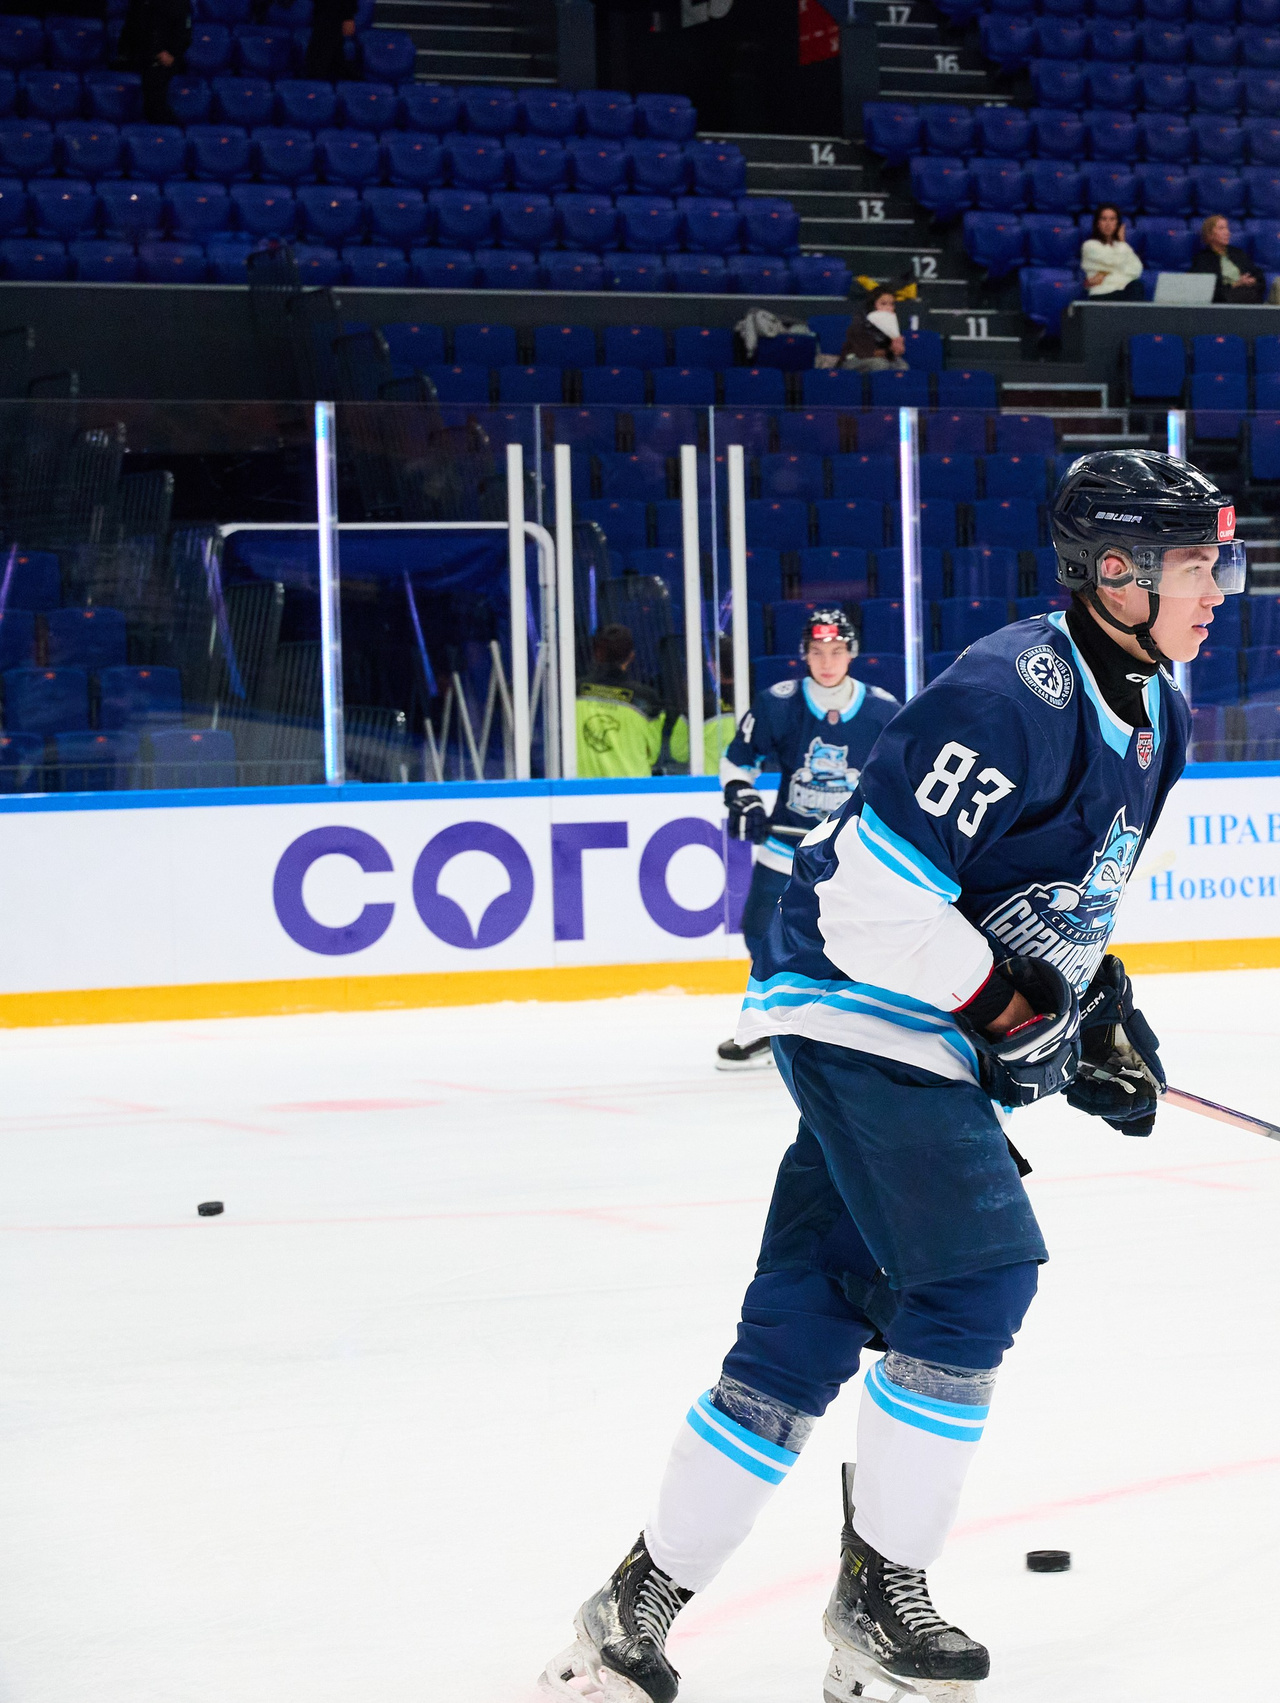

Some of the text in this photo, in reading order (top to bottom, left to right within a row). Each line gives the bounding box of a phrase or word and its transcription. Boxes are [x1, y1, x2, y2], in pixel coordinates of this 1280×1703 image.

[888, 6, 911, 25] 17
[935, 54, 959, 74] 16
[810, 143, 836, 167] 14
[859, 199, 885, 223] 13
[911, 256, 938, 278] 12
[966, 317, 988, 339] 11
[1095, 511, 1142, 524] BAUER
[914, 741, 1017, 838] 83
[273, 817, 752, 956] сога
[1080, 991, 1105, 1020] CCM
